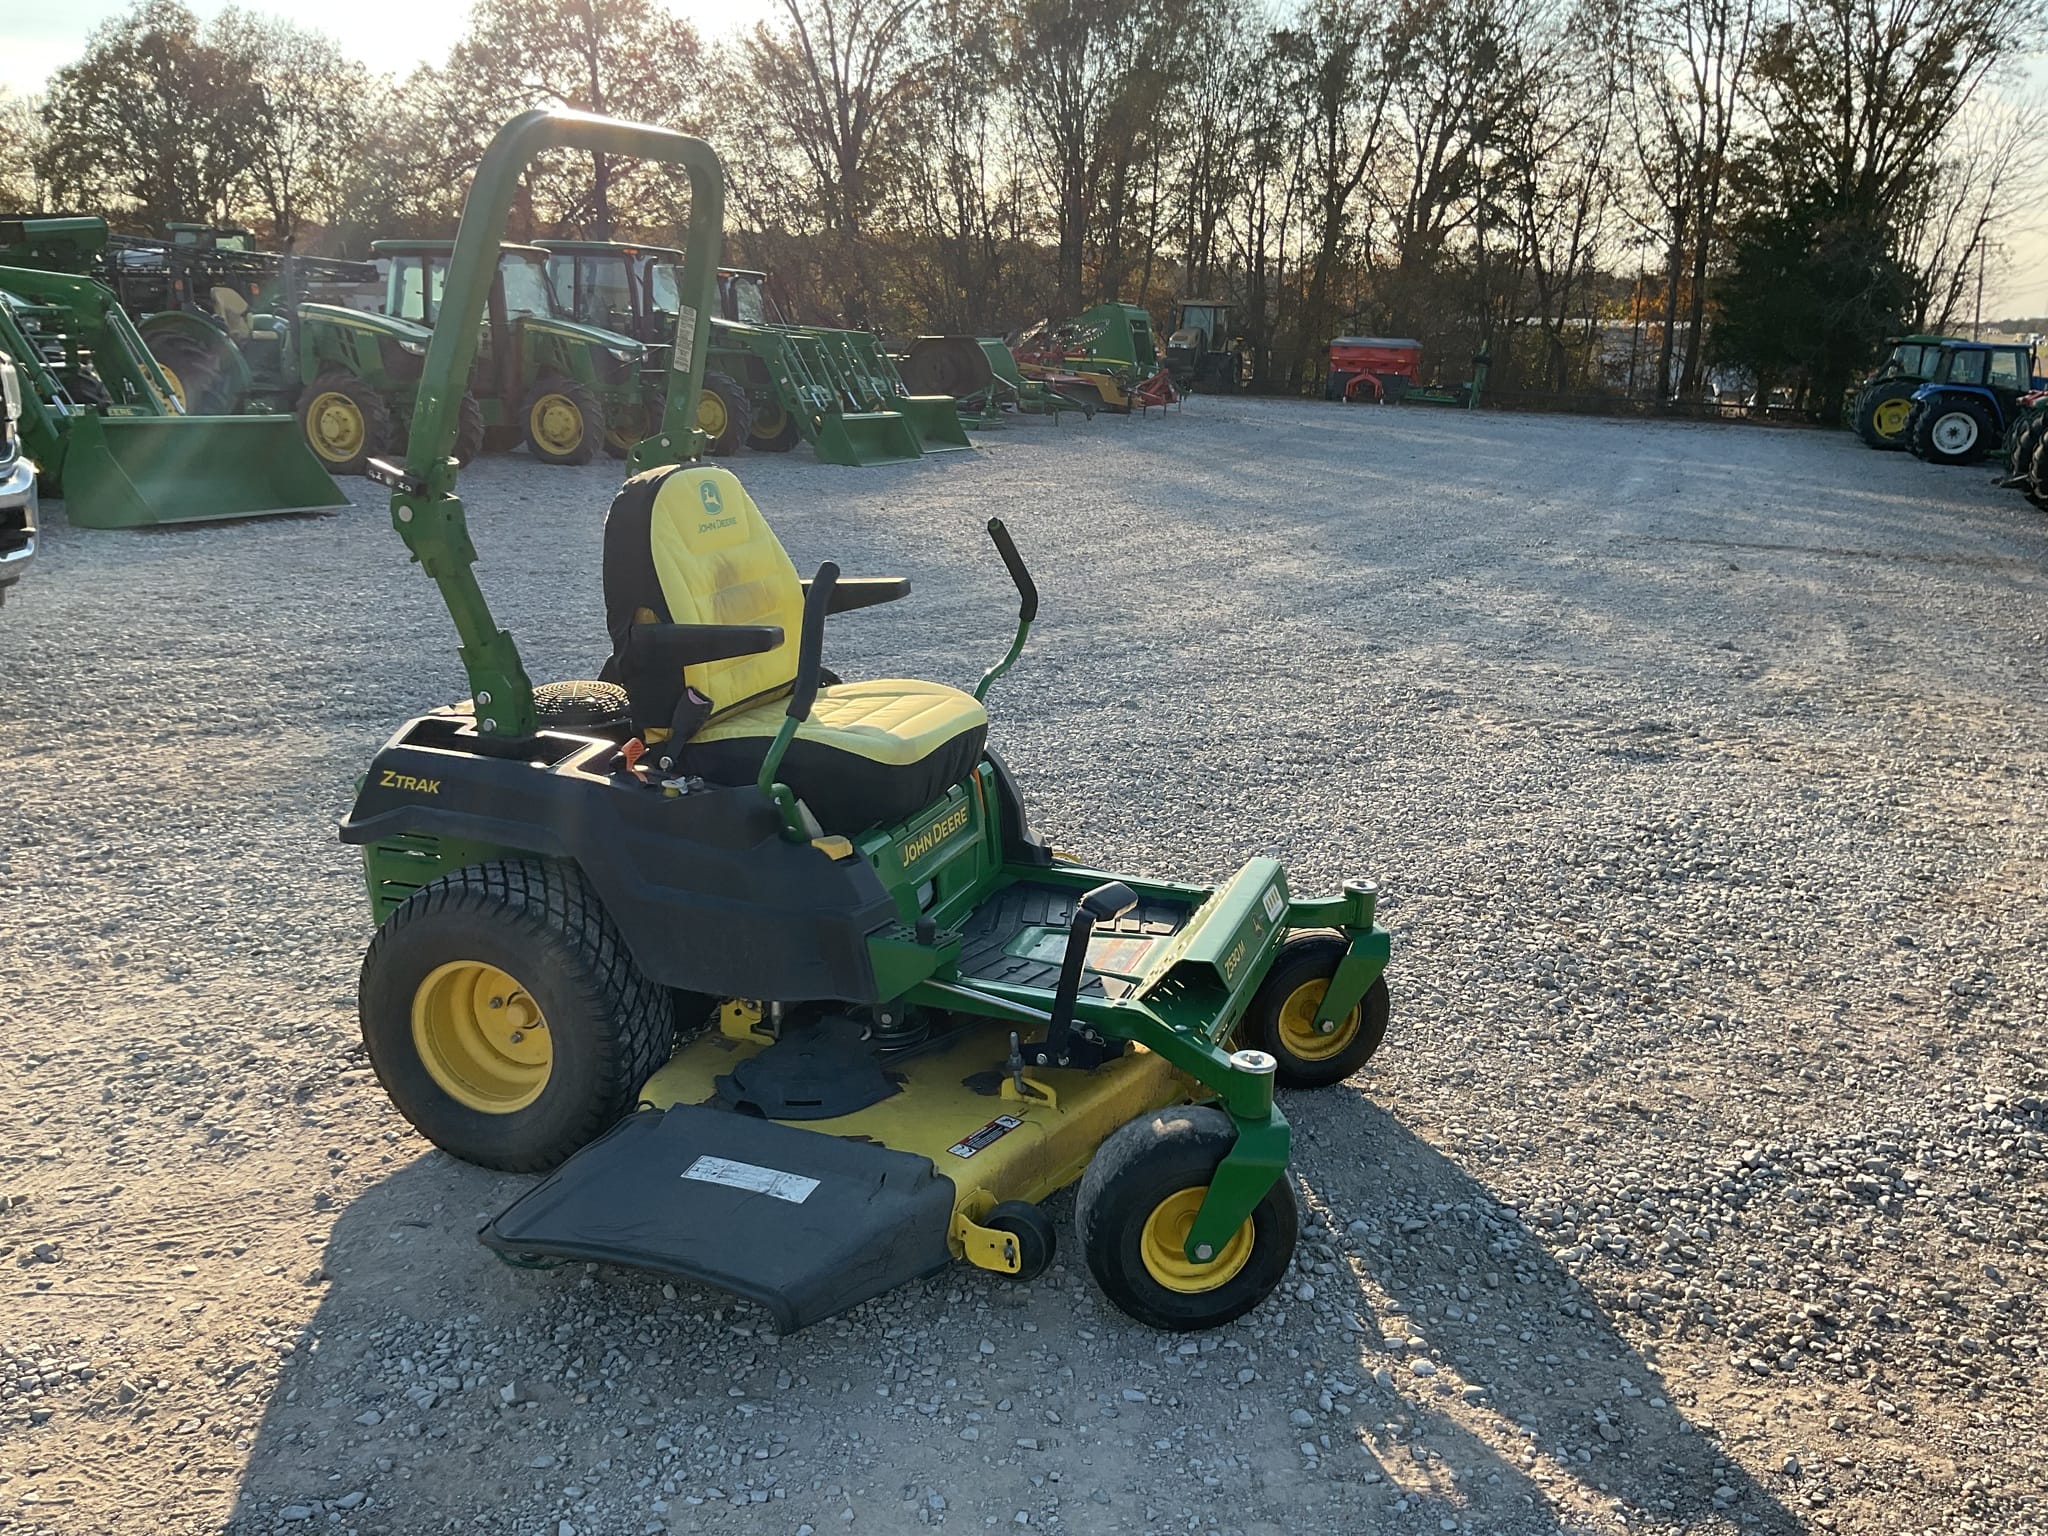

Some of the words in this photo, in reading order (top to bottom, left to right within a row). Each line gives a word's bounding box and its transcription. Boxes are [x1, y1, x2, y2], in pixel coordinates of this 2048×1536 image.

[698, 522, 716, 534] JOHN
[716, 517, 737, 530] DEERE
[380, 770, 441, 794] ZTRAK
[903, 831, 933, 867] JOHN
[932, 806, 968, 843] DEERE
[1224, 939, 1247, 980] Z530M
